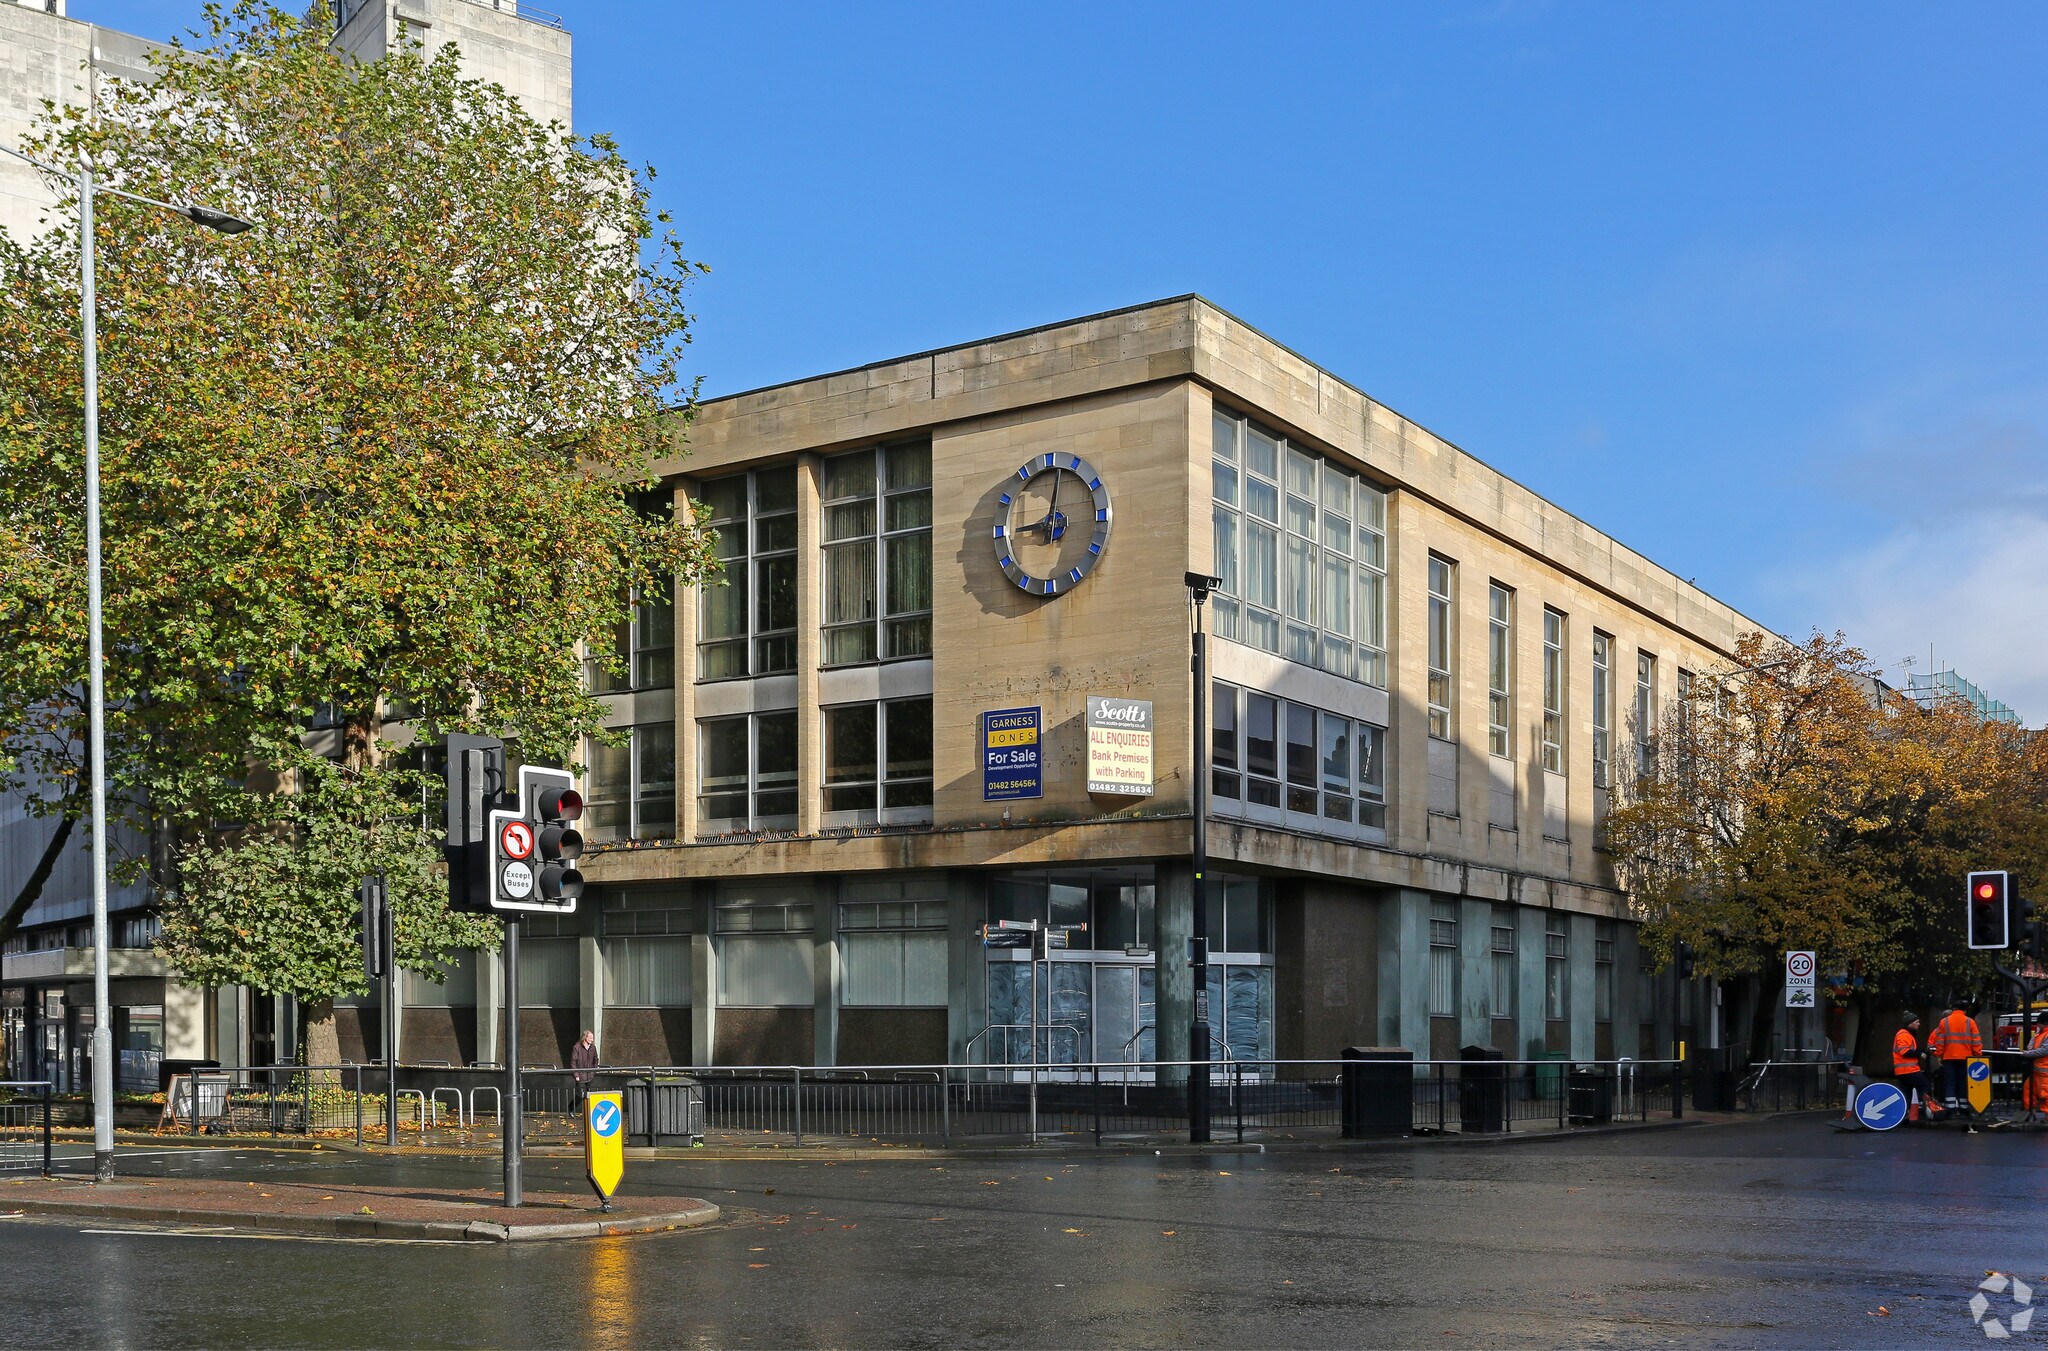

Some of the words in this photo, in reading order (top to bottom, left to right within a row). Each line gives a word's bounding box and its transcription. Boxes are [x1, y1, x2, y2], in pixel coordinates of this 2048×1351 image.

[1095, 700, 1145, 722] Scotts
[991, 716, 1033, 728] GARNESS
[992, 732, 1033, 744] JONES
[1091, 731, 1105, 744] ALL
[1106, 732, 1150, 748] ENQUIRIES
[988, 752, 1008, 765] For
[1010, 749, 1036, 762] Sale
[1092, 750, 1111, 761] Bank
[1113, 751, 1149, 764] Premises
[1096, 766, 1113, 776] with
[1115, 767, 1146, 781] Parking
[988, 781, 1009, 790] 01482
[1010, 780, 1036, 789] 564564
[1089, 783, 1116, 792] 01482
[1119, 785, 1151, 794] 325634
[506, 871, 530, 880] Except
[1793, 960, 1809, 969] 20
